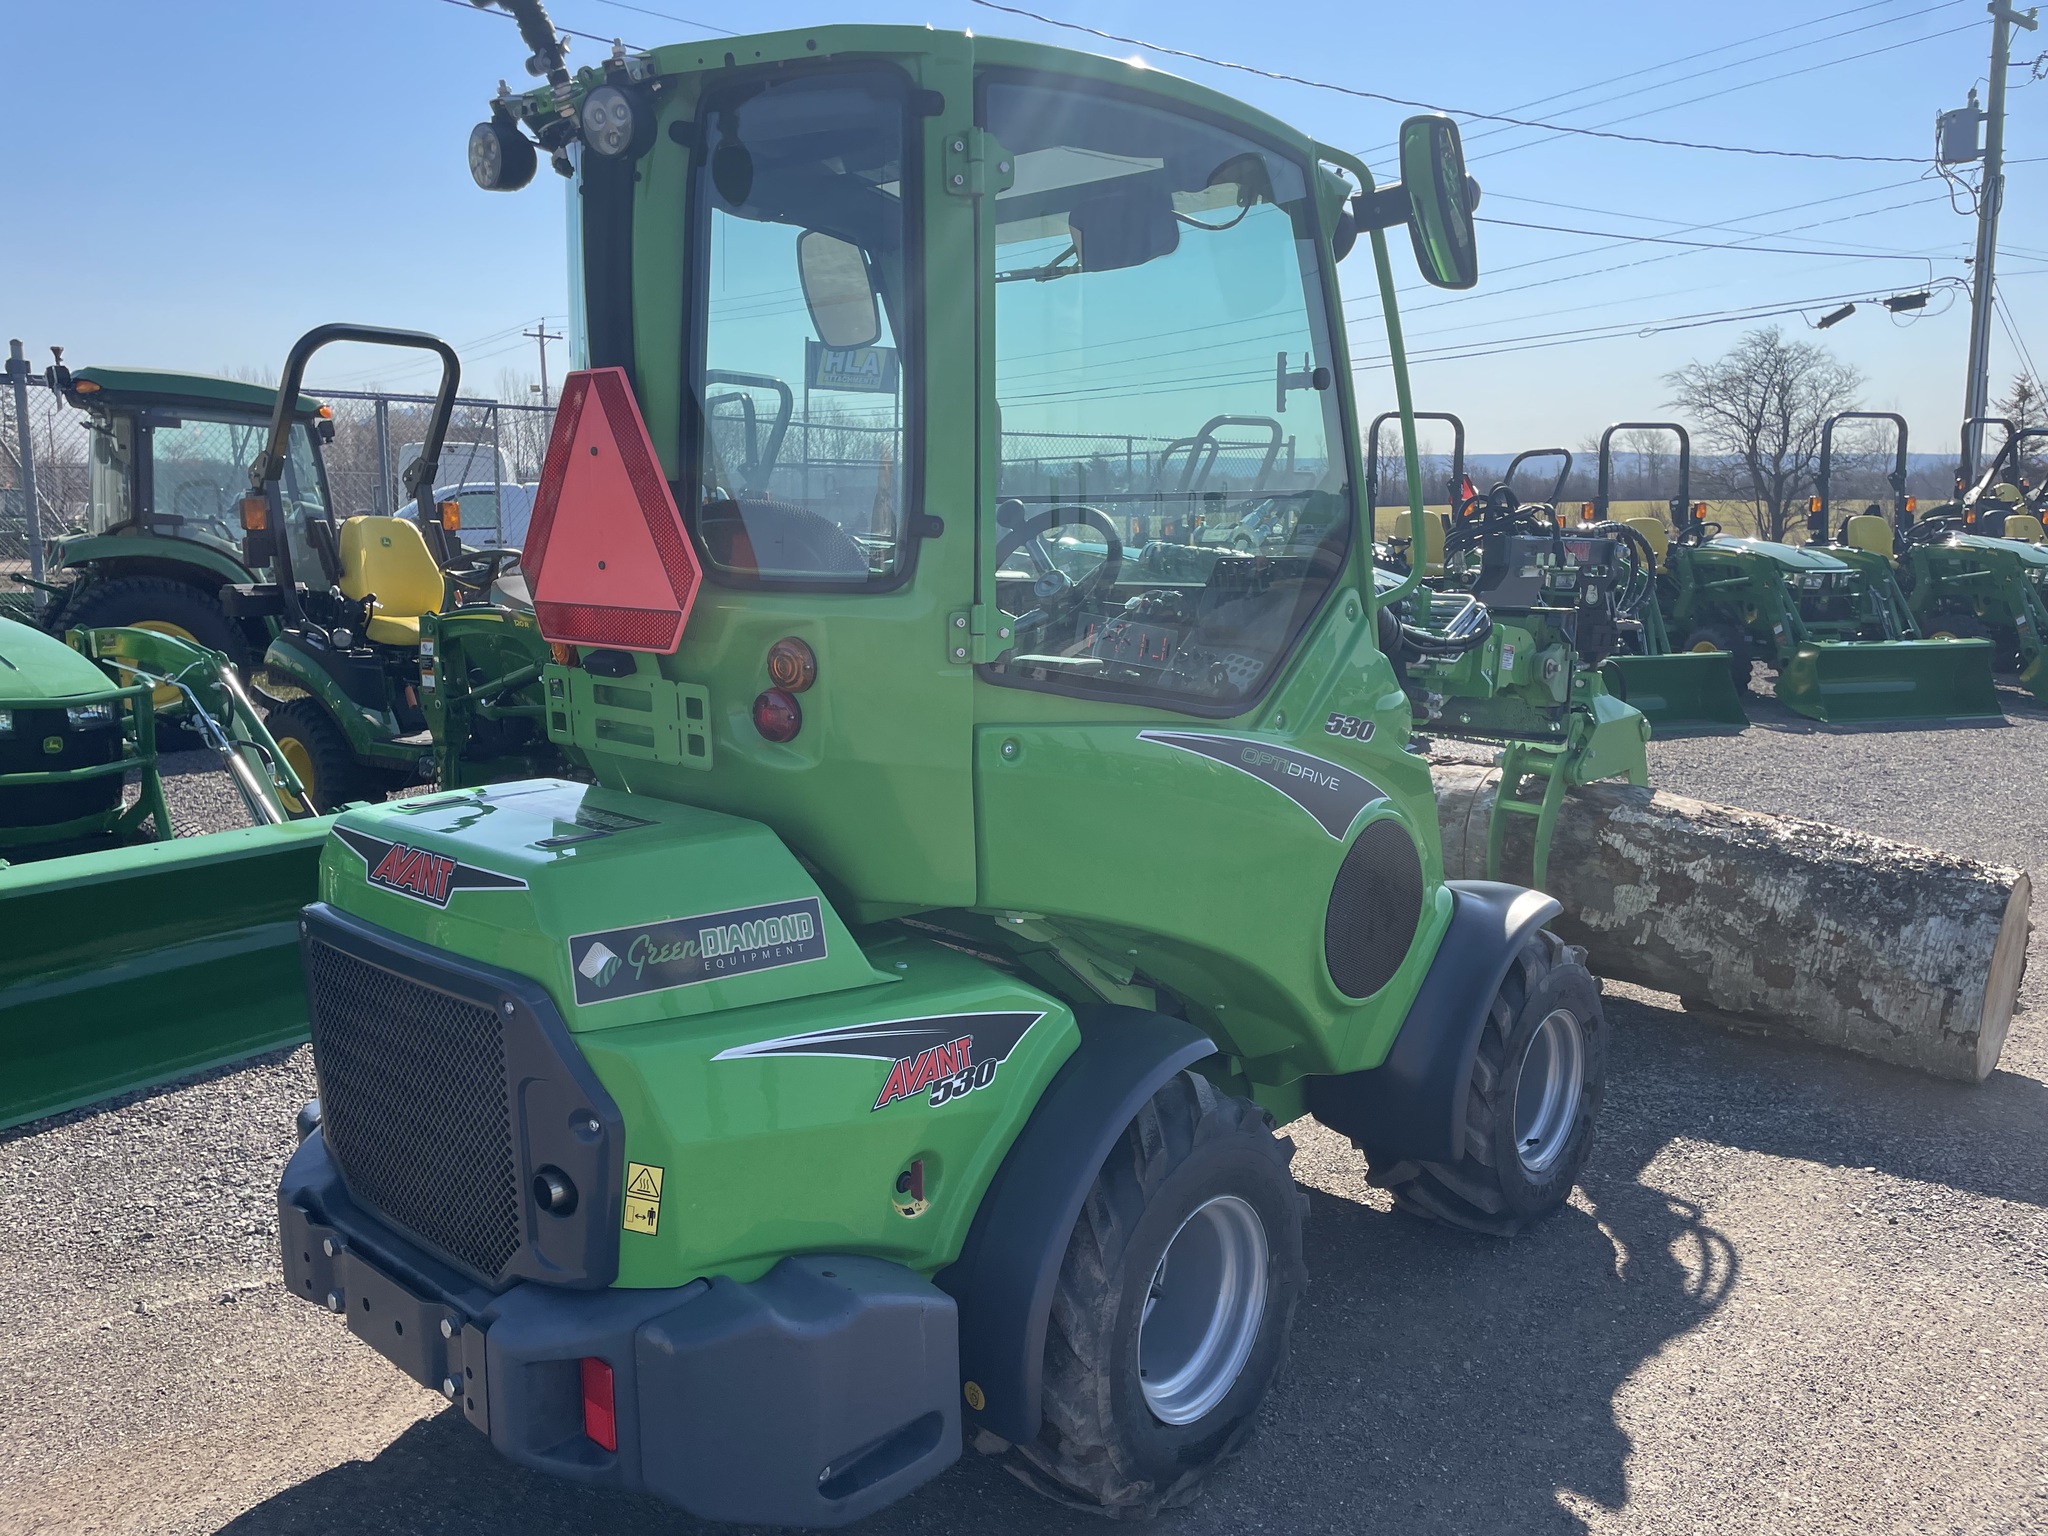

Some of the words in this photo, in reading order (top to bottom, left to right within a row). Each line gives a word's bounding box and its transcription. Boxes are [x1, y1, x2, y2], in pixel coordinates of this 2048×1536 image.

[824, 350, 879, 376] HLA
[1324, 712, 1376, 743] 530
[370, 843, 457, 902] AVANT
[627, 933, 701, 981] Green
[698, 911, 815, 959] DIAMOND
[704, 943, 805, 971] EQUIPMENT
[872, 1034, 972, 1112] AVANT
[928, 1058, 998, 1108] 530
